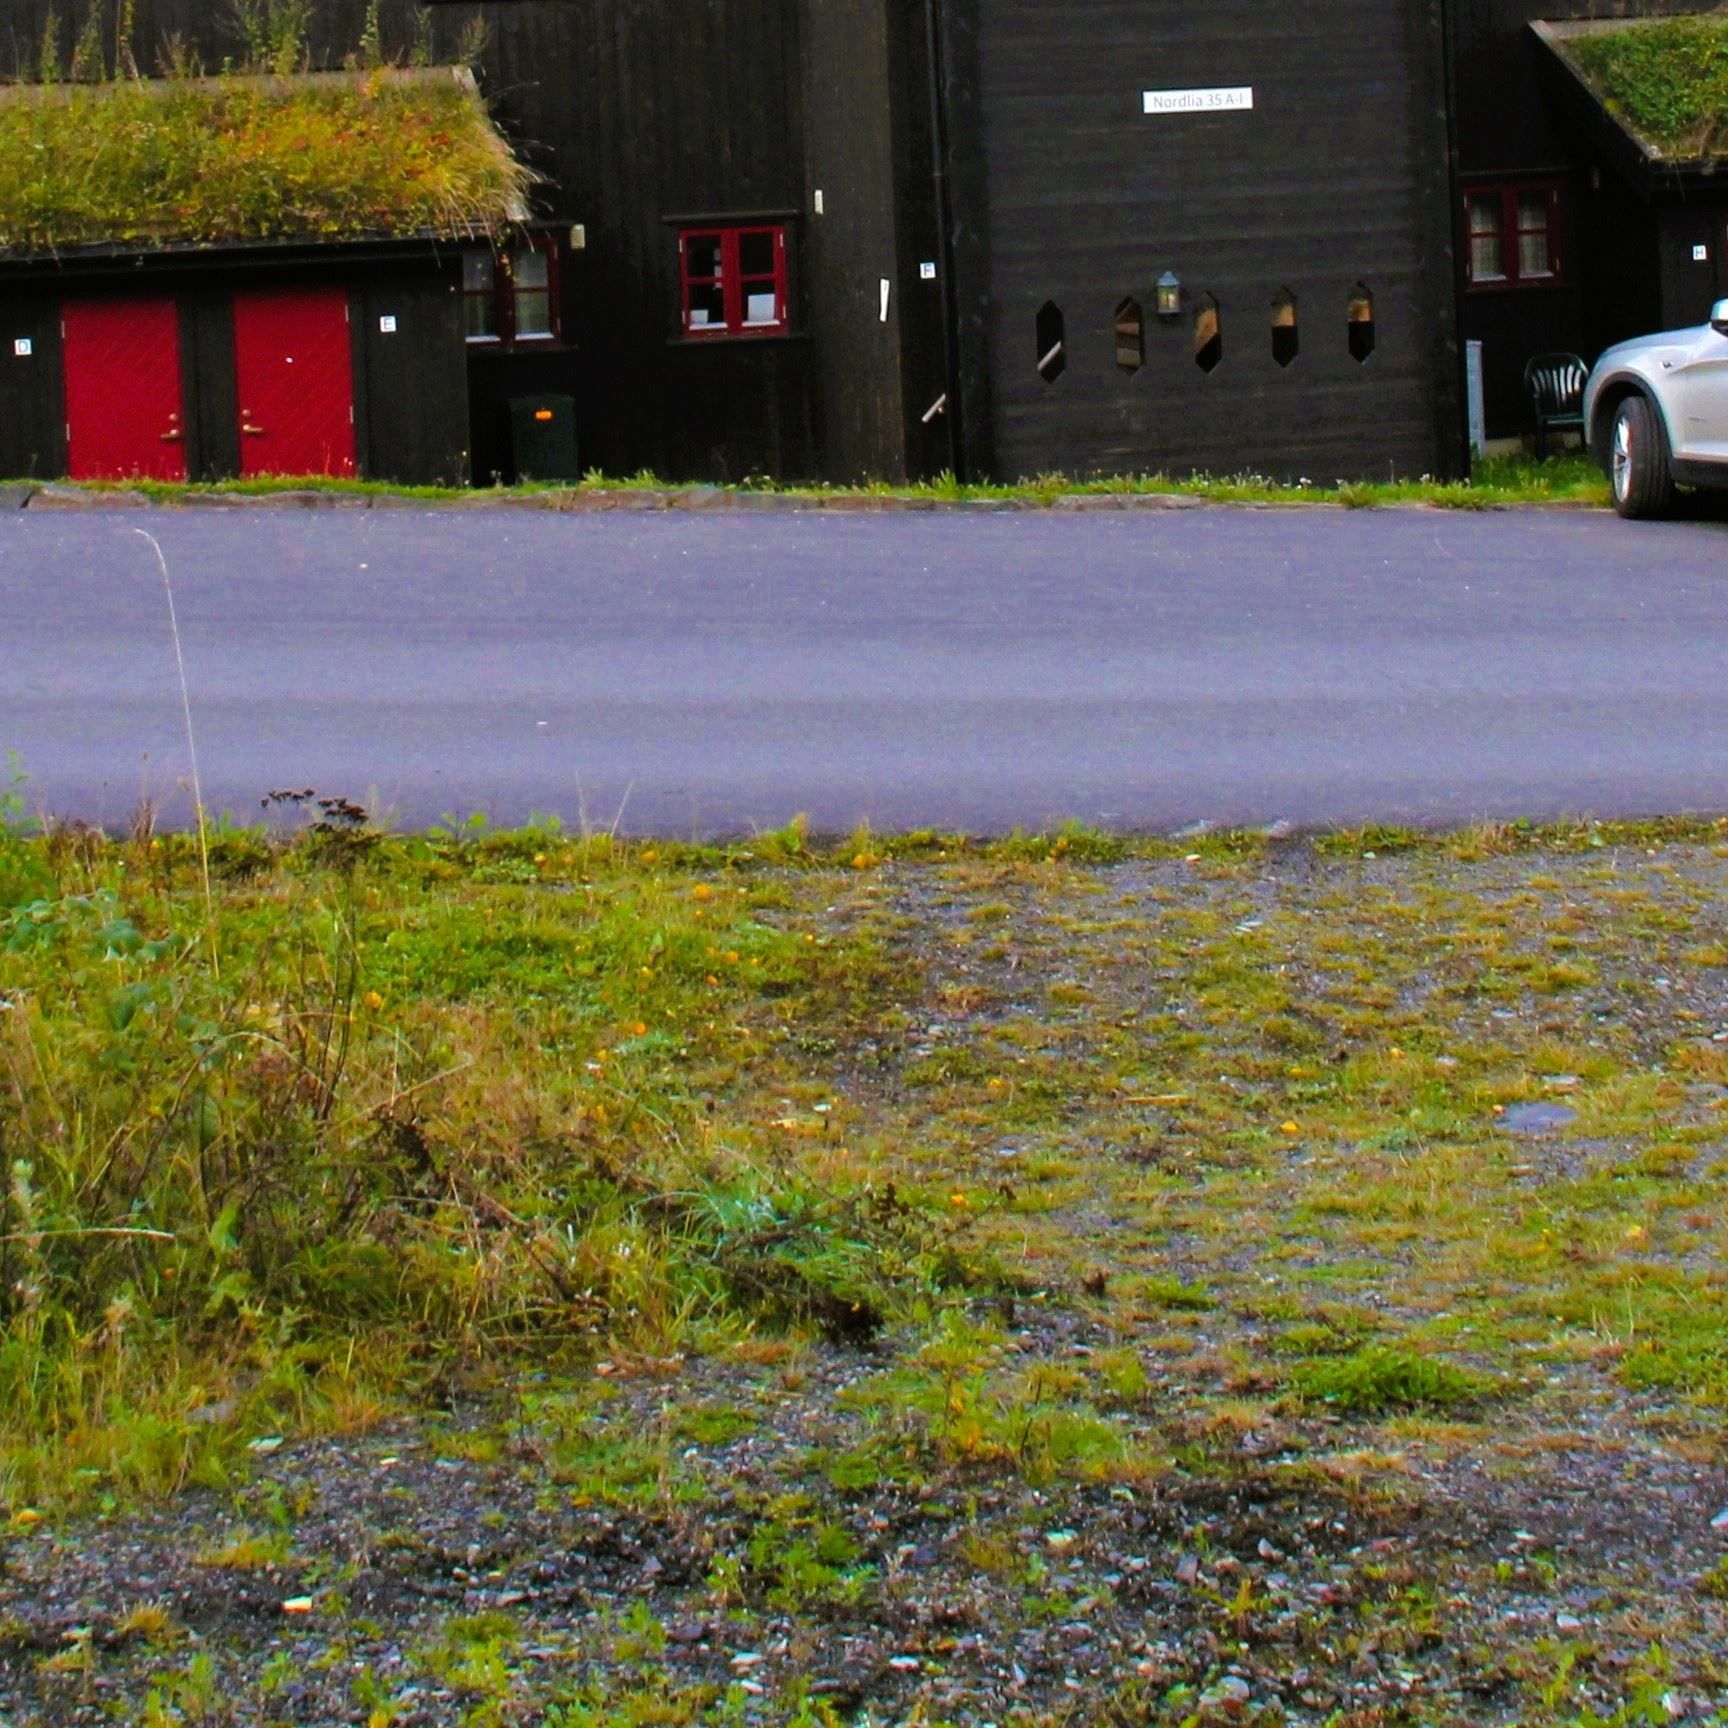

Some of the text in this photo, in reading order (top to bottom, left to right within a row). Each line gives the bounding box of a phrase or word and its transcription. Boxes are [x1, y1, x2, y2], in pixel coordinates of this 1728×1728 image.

[1153, 94, 1203, 109] Nordlia
[1207, 94, 1222, 106] 35
[18, 340, 28, 353] D
